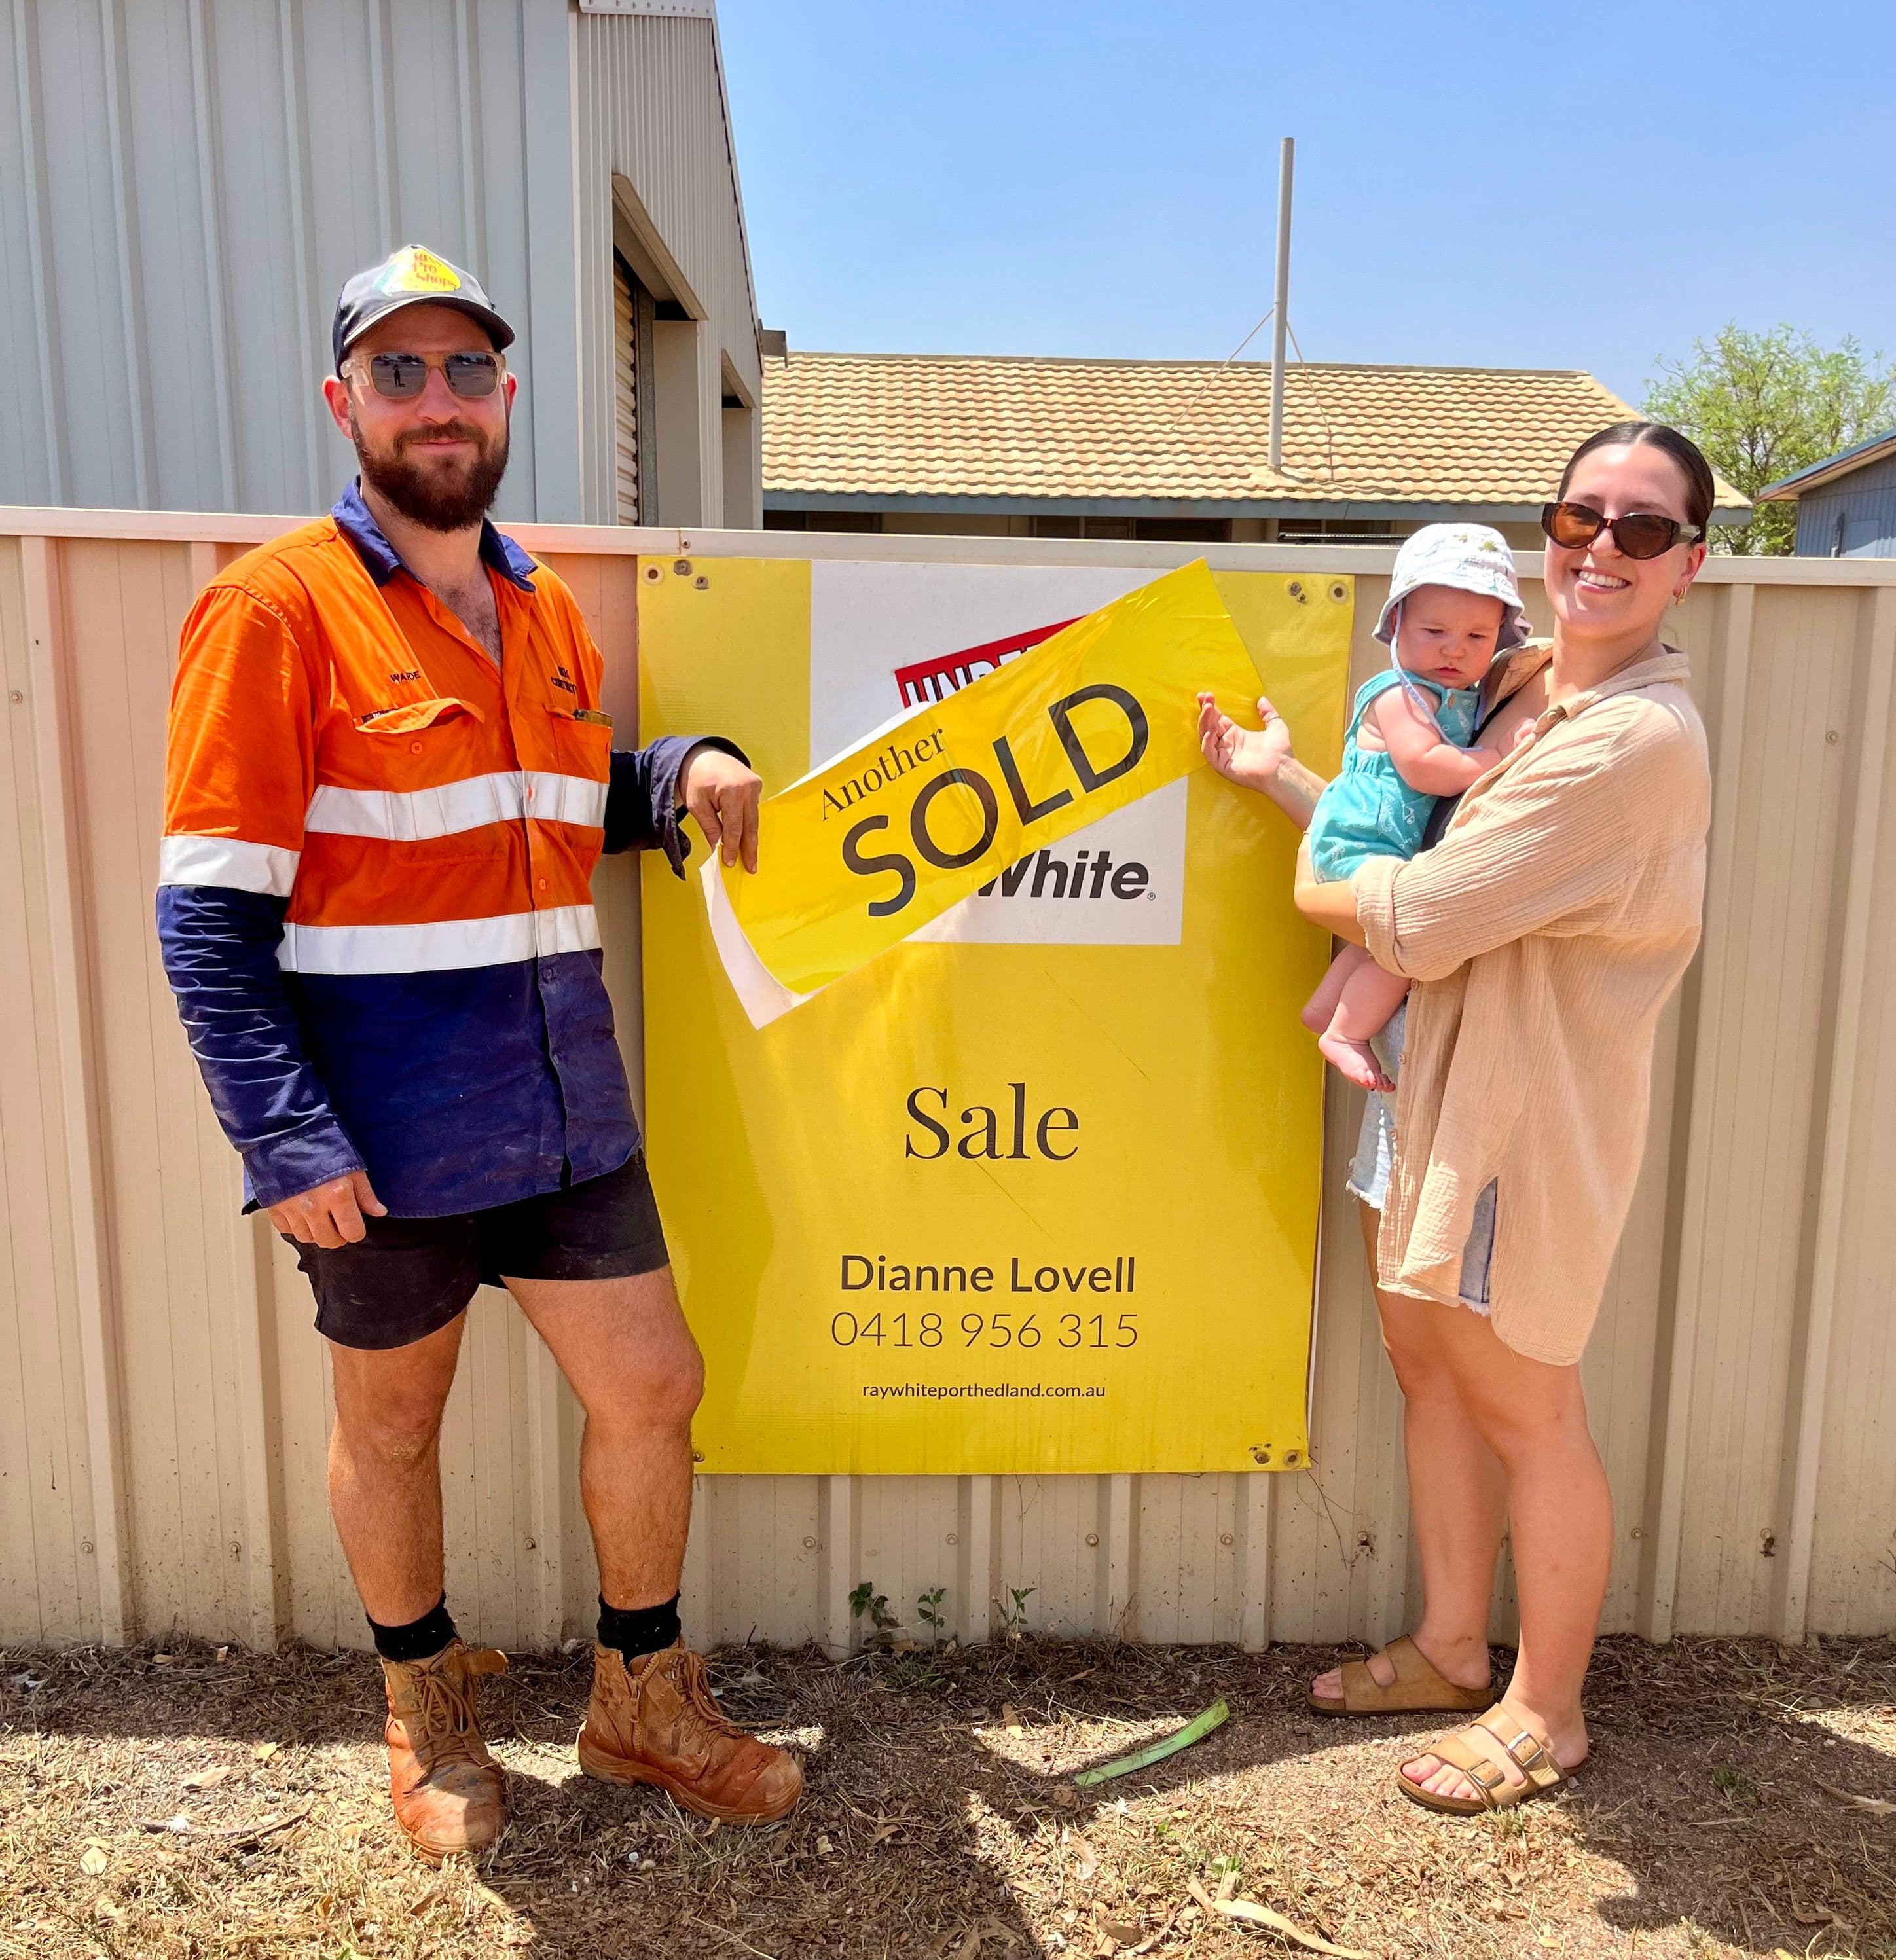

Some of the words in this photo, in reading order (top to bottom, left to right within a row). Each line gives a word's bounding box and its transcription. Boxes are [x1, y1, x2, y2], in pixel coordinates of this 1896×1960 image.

[822, 728, 946, 822] Another
[842, 684, 1150, 917] SOLD
[905, 1082, 1079, 1161] Sale
[841, 1255, 994, 1292] Dianne
[1011, 1256, 1135, 1292] Lovell
[831, 1311, 943, 1347] 0418
[960, 1313, 1042, 1347] 956
[1058, 1313, 1138, 1348] 315
[862, 1383, 1106, 1400] raywhiteporthedland.com.au
